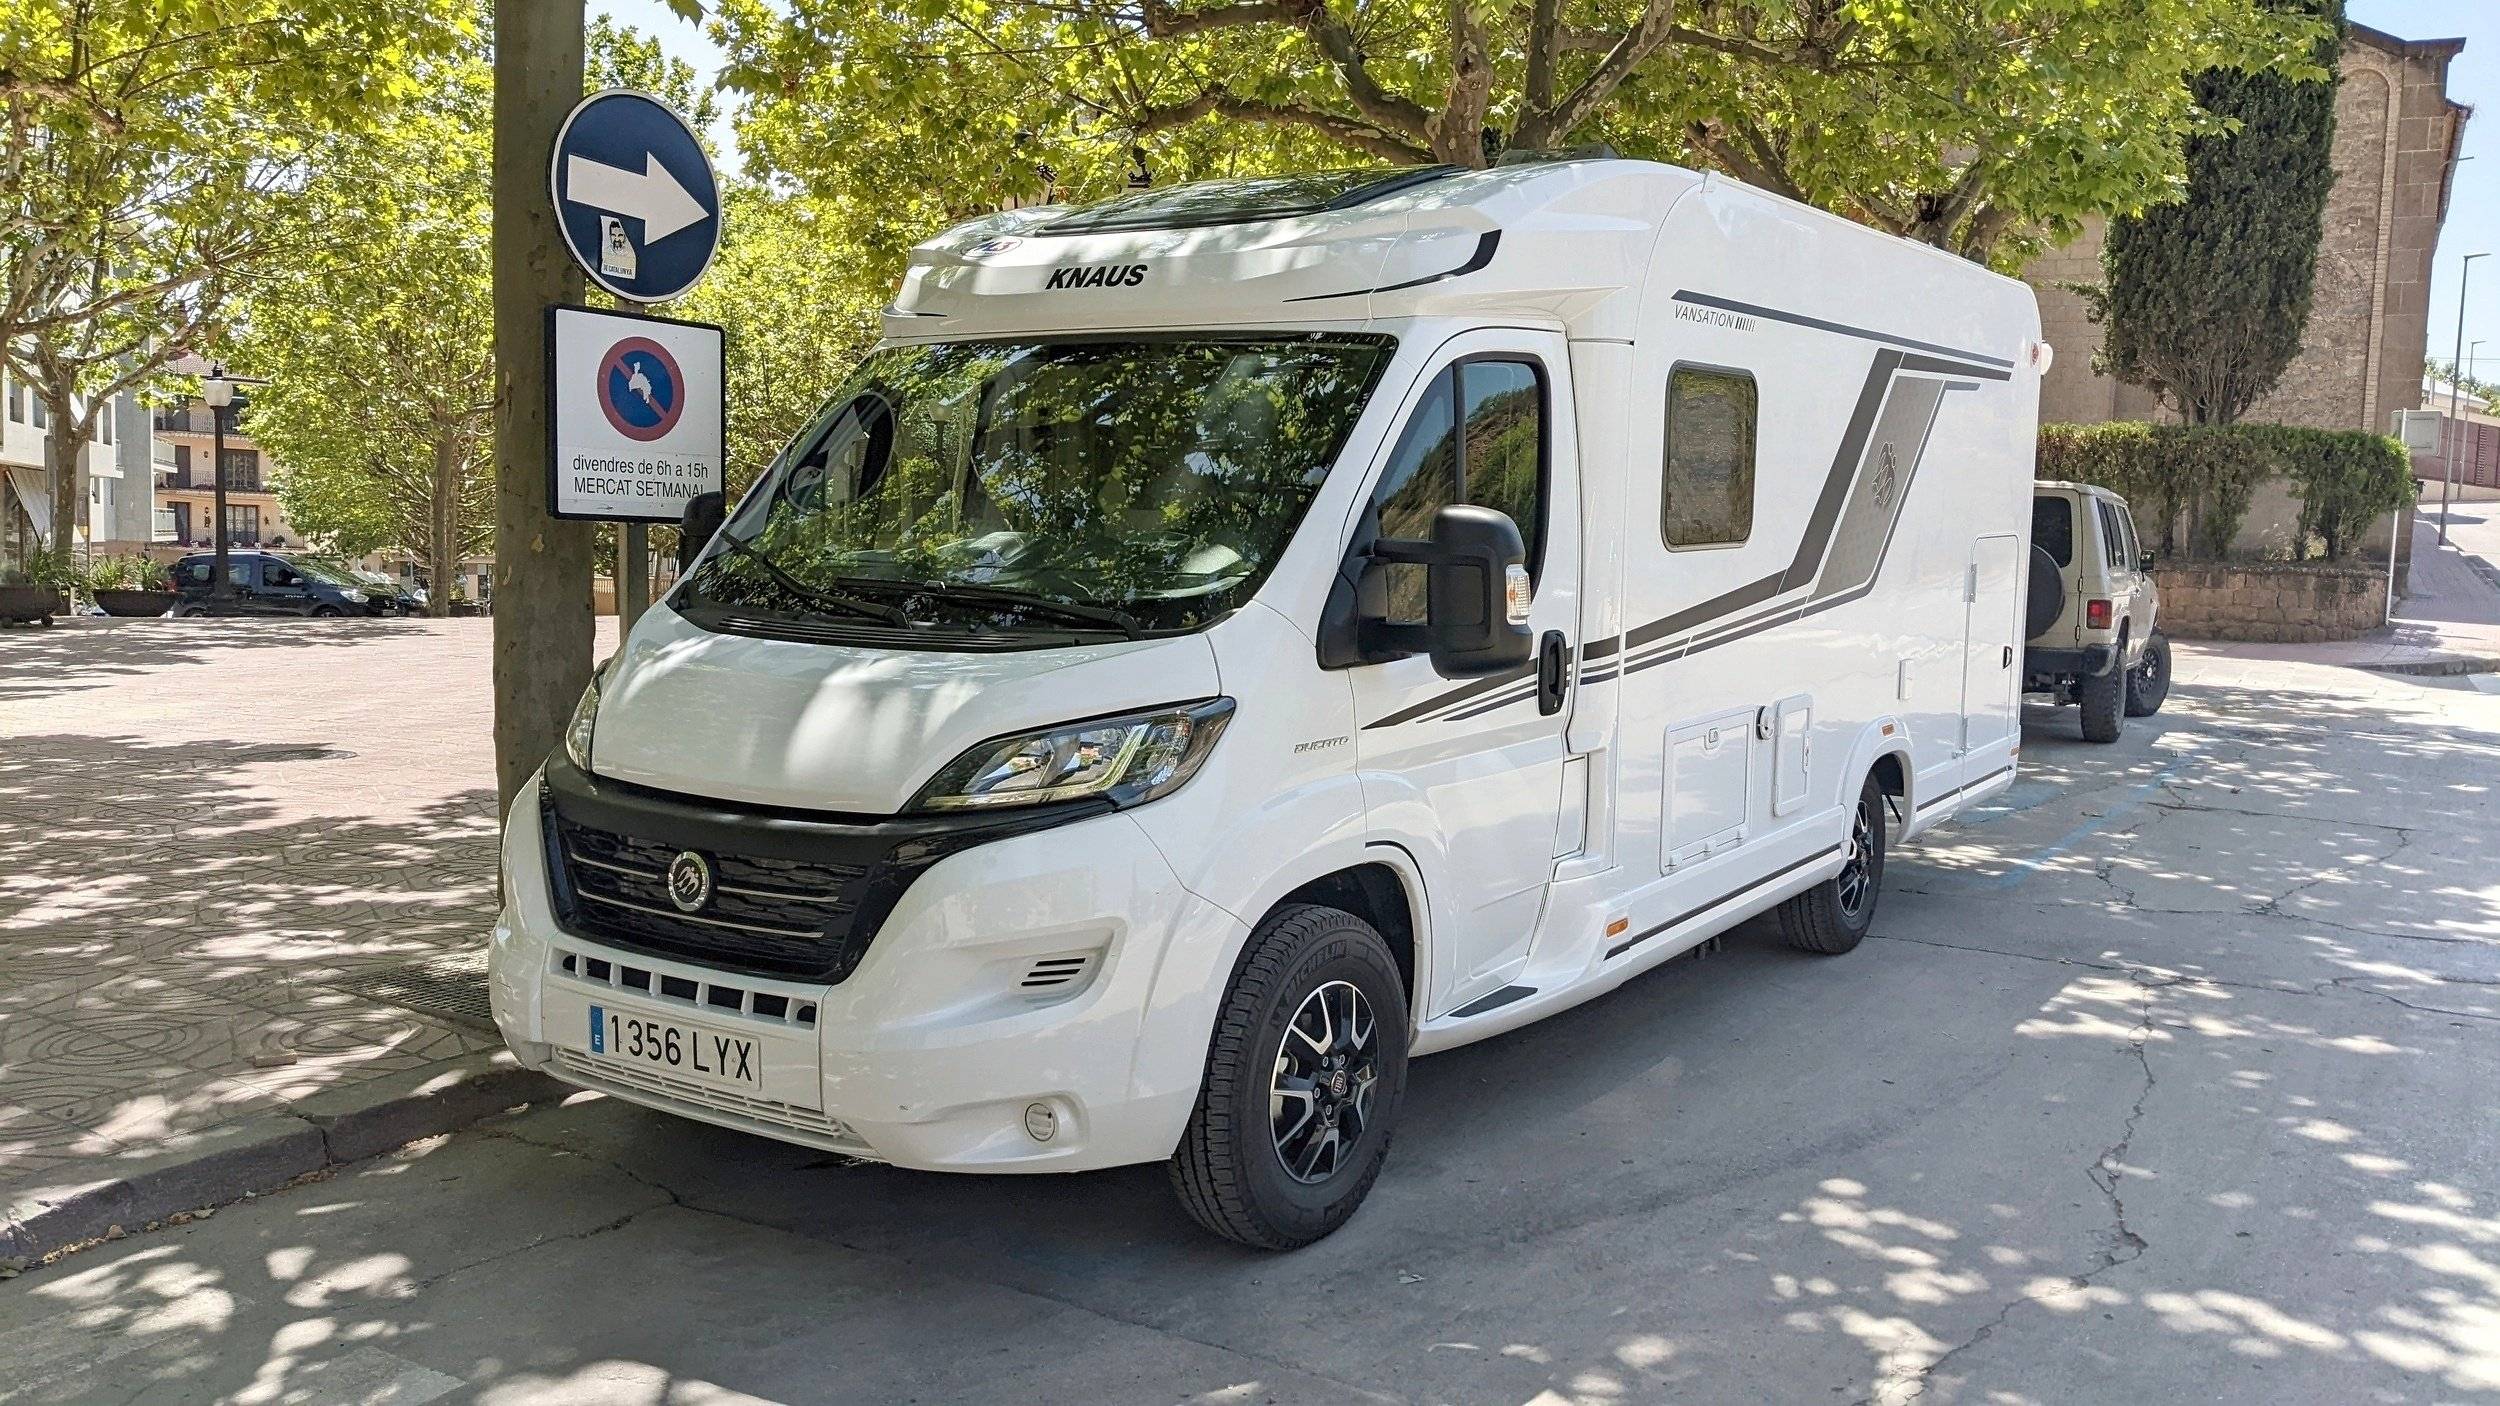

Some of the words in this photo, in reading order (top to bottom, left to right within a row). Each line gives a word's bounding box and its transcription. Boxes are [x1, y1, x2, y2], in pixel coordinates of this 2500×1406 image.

[1045, 264, 1148, 290] KNAUS
[1675, 304, 1735, 329] VANSATION
[573, 455, 634, 474] divendres
[638, 459, 653, 475] de
[656, 460, 672, 476] 6h
[675, 464, 683, 476] a
[687, 463, 708, 479] 15h
[574, 477, 632, 496] MERCAT
[594, 1034, 601, 1045] E
[611, 1015, 681, 1066] 1356
[692, 1031, 752, 1082] LYX
